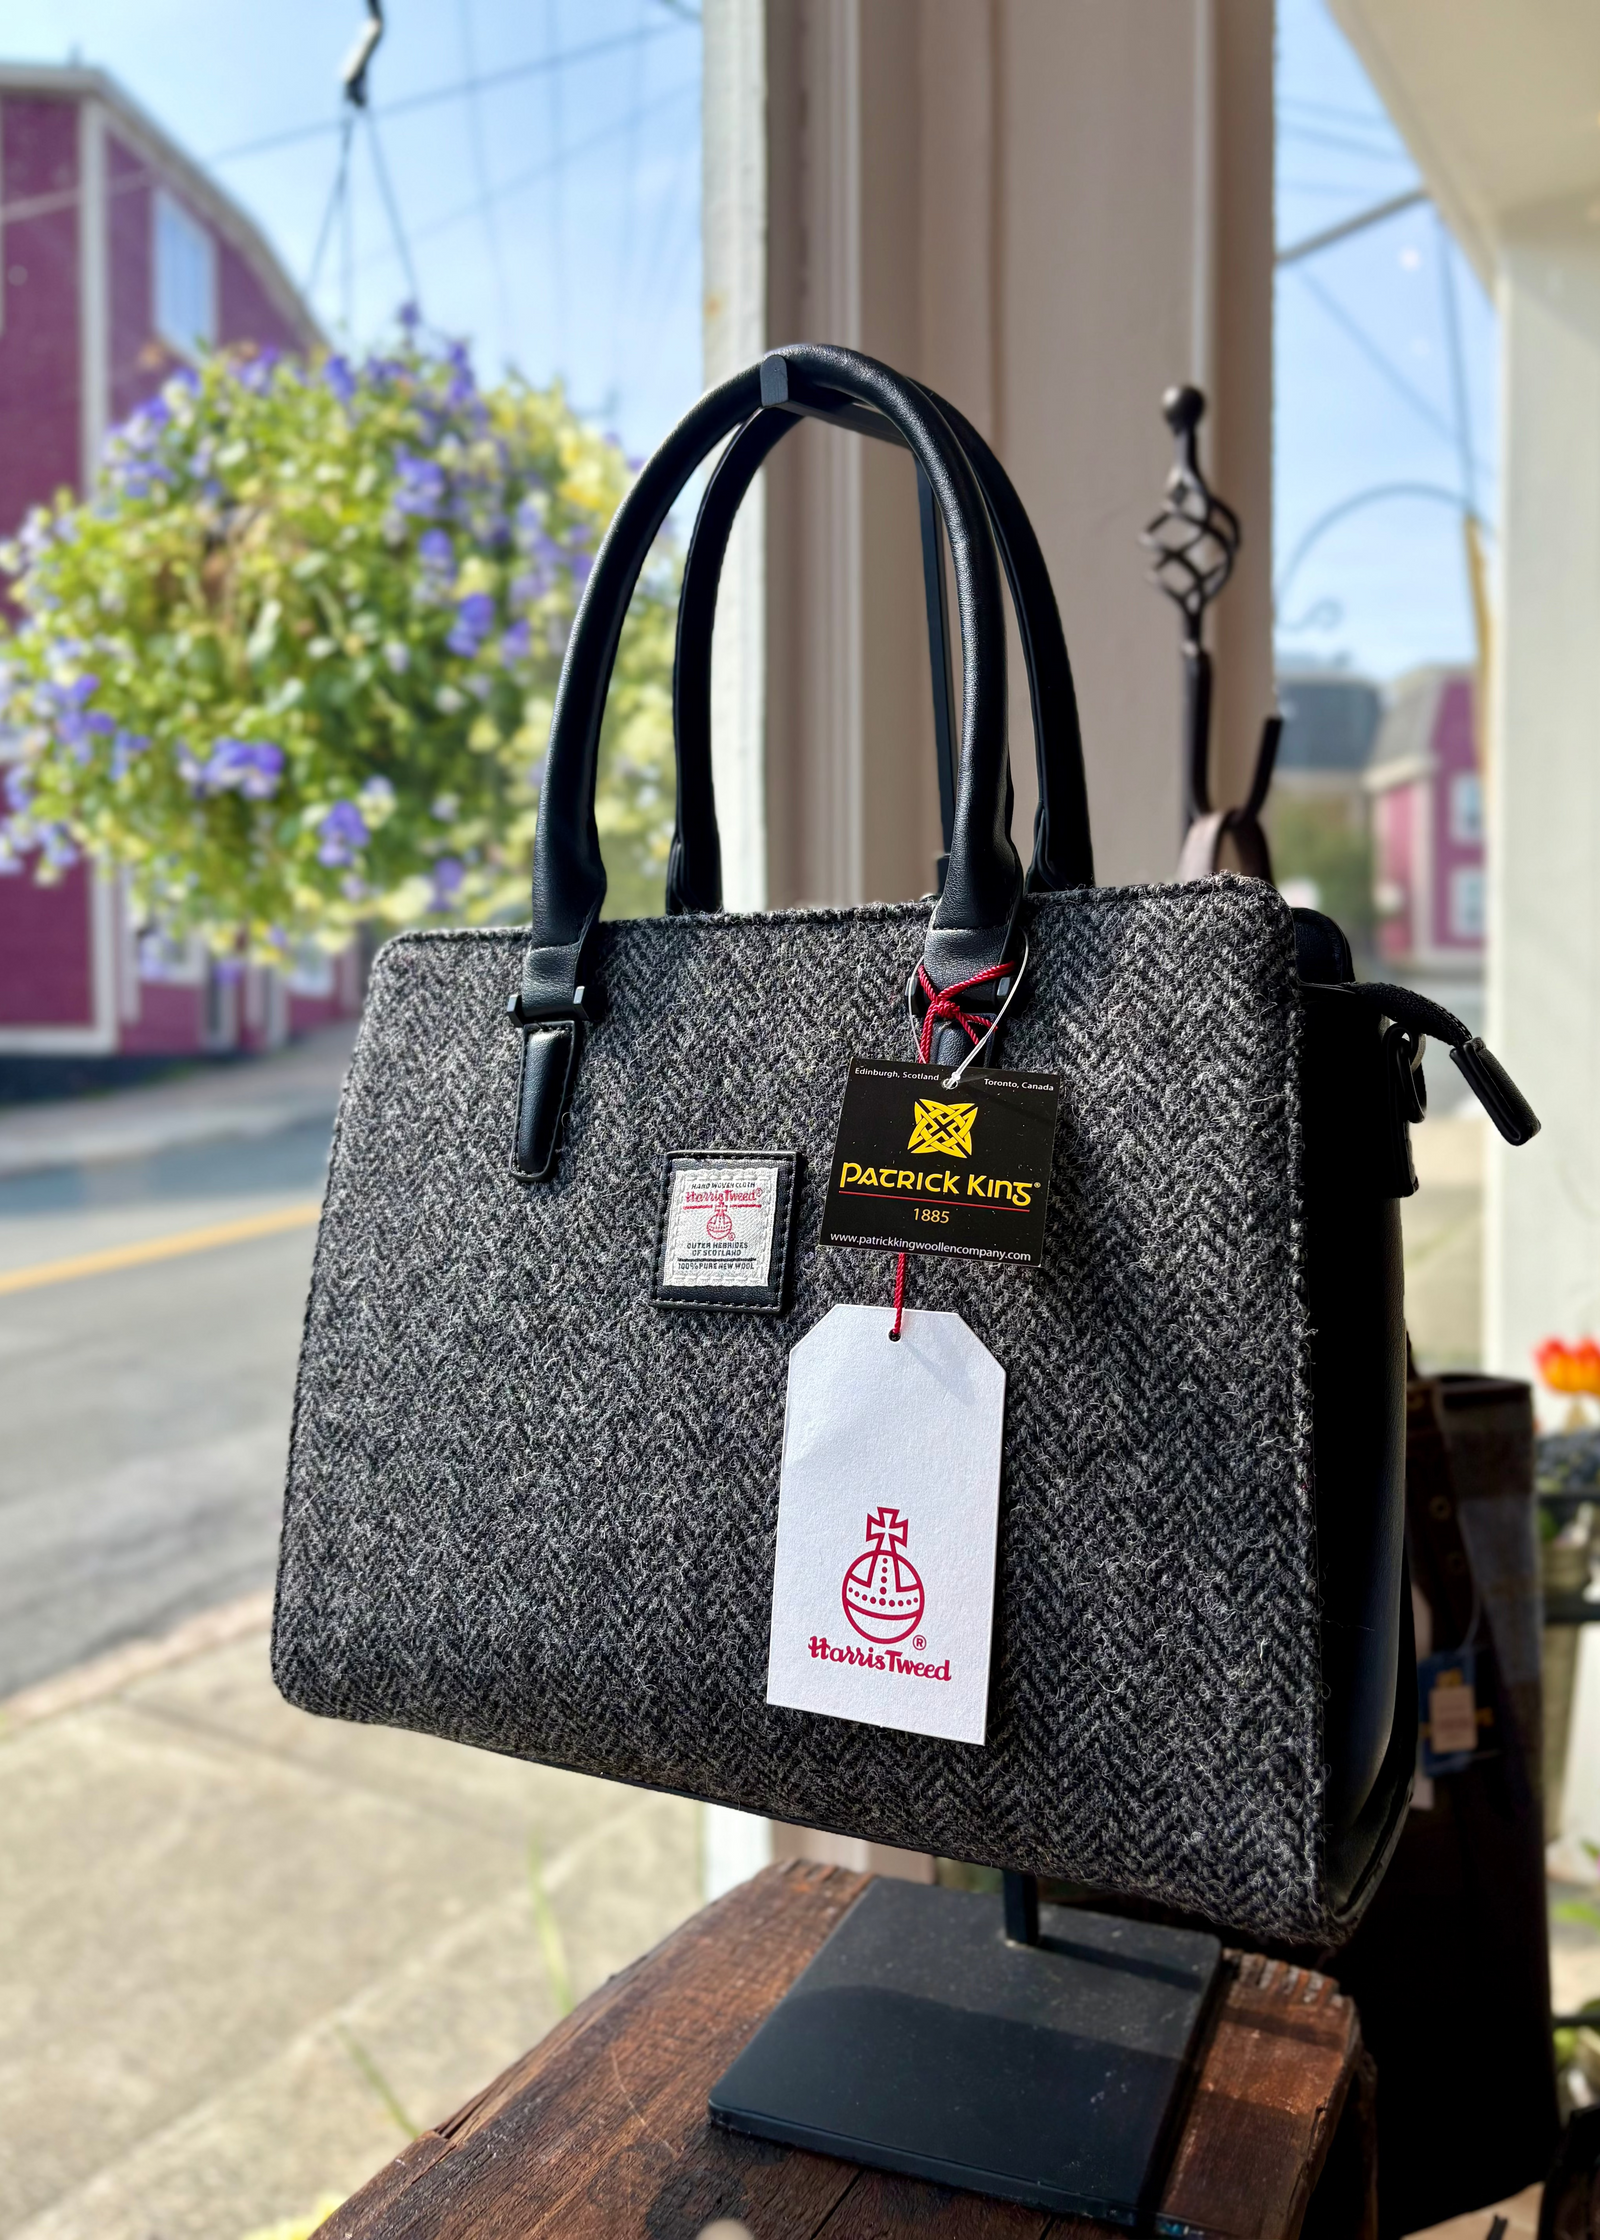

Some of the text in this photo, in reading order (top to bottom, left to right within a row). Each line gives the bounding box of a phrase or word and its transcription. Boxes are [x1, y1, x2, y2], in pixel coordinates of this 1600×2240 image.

[854, 1067, 940, 1081] Edinburgh, Scotland
[984, 1078, 1054, 1091] Toronto, Canada
[839, 1162, 960, 1195] PATRICK
[913, 1208, 950, 1224] 1885
[712, 1241, 748, 1249] HEBRIDES
[830, 1232, 1031, 1262] www.patrickkingwoollencompany.com
[703, 1249, 742, 1257] SCOTLAND
